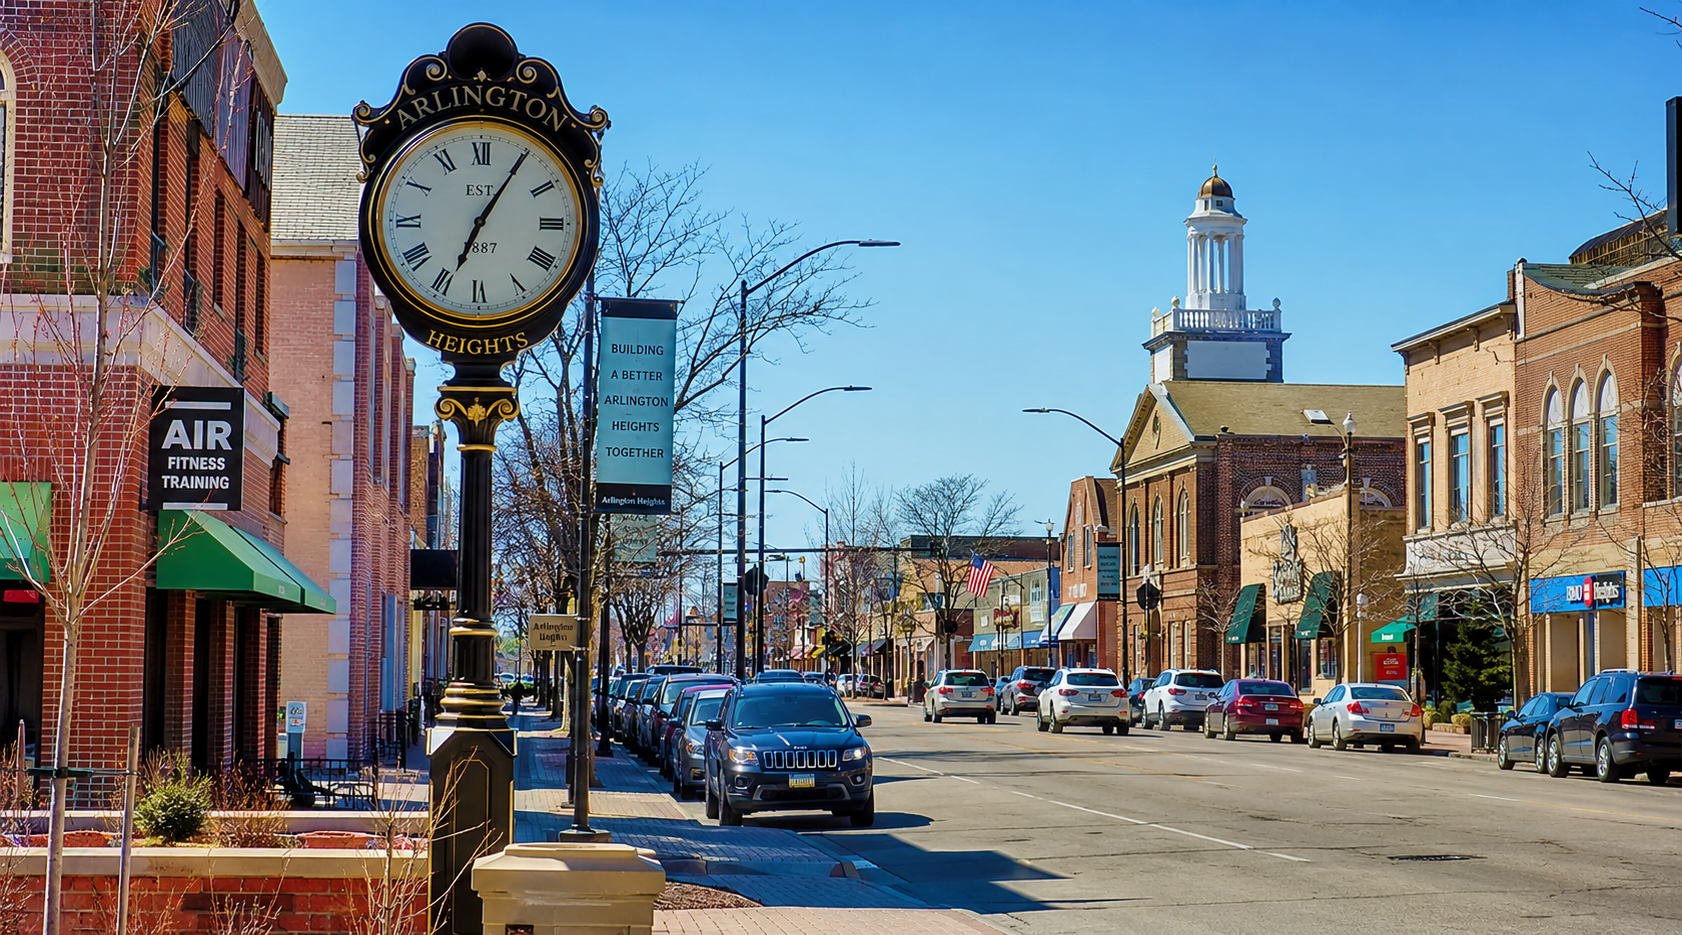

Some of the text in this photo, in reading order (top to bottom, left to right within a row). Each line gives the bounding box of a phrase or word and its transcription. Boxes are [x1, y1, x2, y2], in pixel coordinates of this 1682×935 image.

[397, 85, 568, 132] ARLINGTON
[471, 142, 491, 166] XII
[433, 149, 457, 176] XI
[406, 176, 432, 197] X
[530, 180, 556, 199] II
[396, 213, 421, 229] IX
[539, 217, 564, 231] III
[471, 280, 487, 303] VI
[426, 329, 529, 355] HEIGHTS
[611, 344, 664, 355] BUILDING
[611, 370, 663, 381] A BETTER
[604, 395, 669, 407] ARLINGTON
[612, 421, 660, 432] HEIGHTS
[161, 420, 232, 450] AIR
[605, 447, 664, 458] TOGETHER
[167, 456, 226, 470] FITNESS
[162, 475, 230, 490] TRAINING
[601, 496, 666, 507] Arlington Heights
